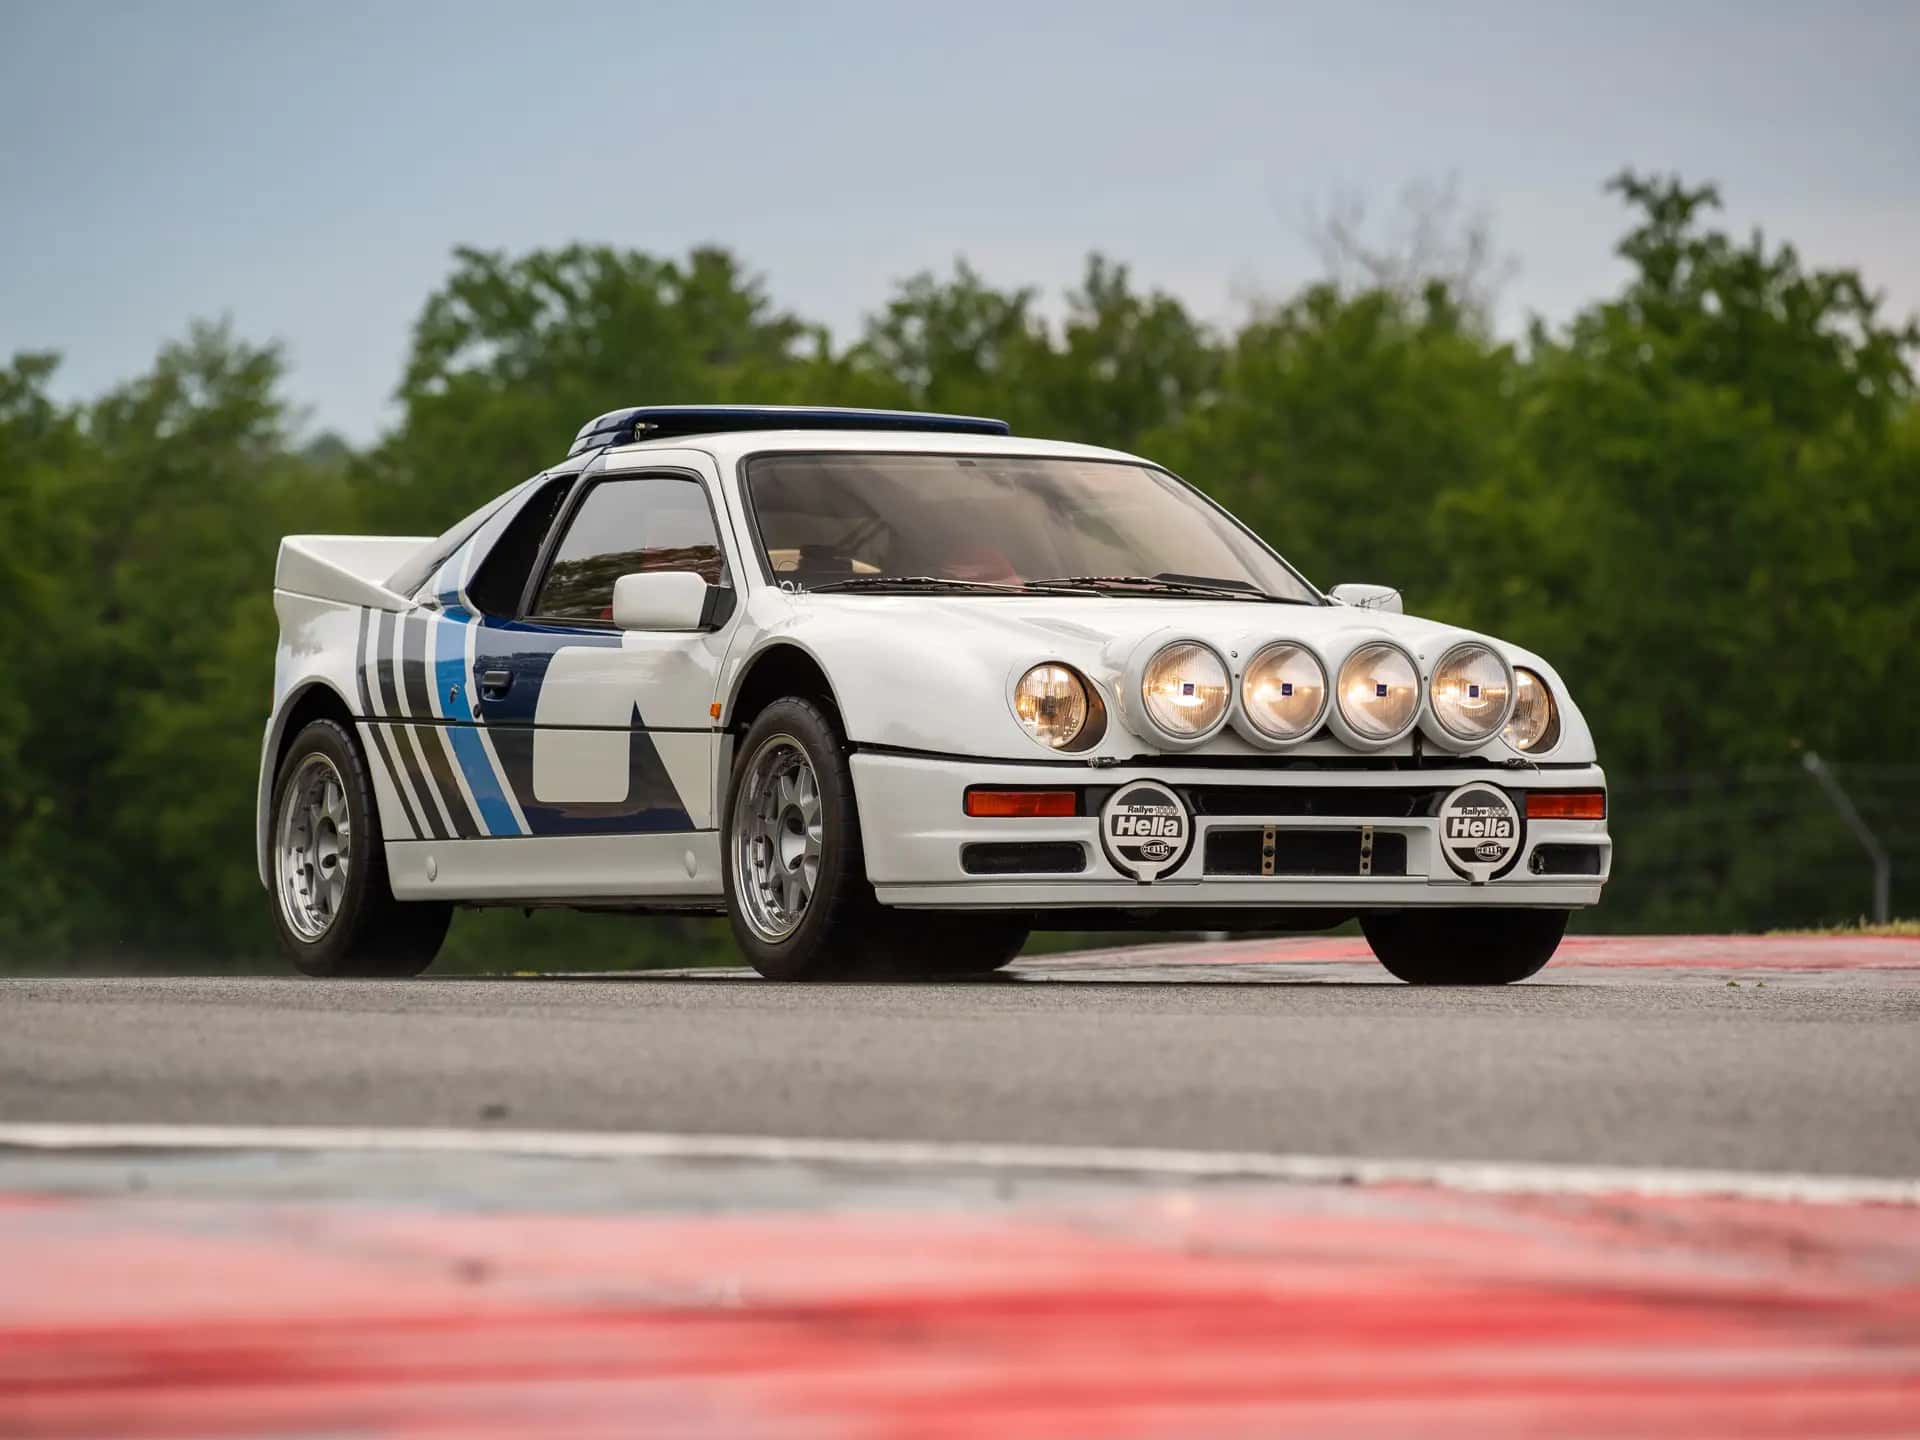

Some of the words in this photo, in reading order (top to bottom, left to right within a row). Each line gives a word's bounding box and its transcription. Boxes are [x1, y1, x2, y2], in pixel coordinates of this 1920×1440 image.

[1127, 805, 1153, 815] Rallye
[1462, 808, 1486, 817] Rallye
[1116, 816, 1178, 836] Hella
[1451, 818, 1510, 837] Hella
